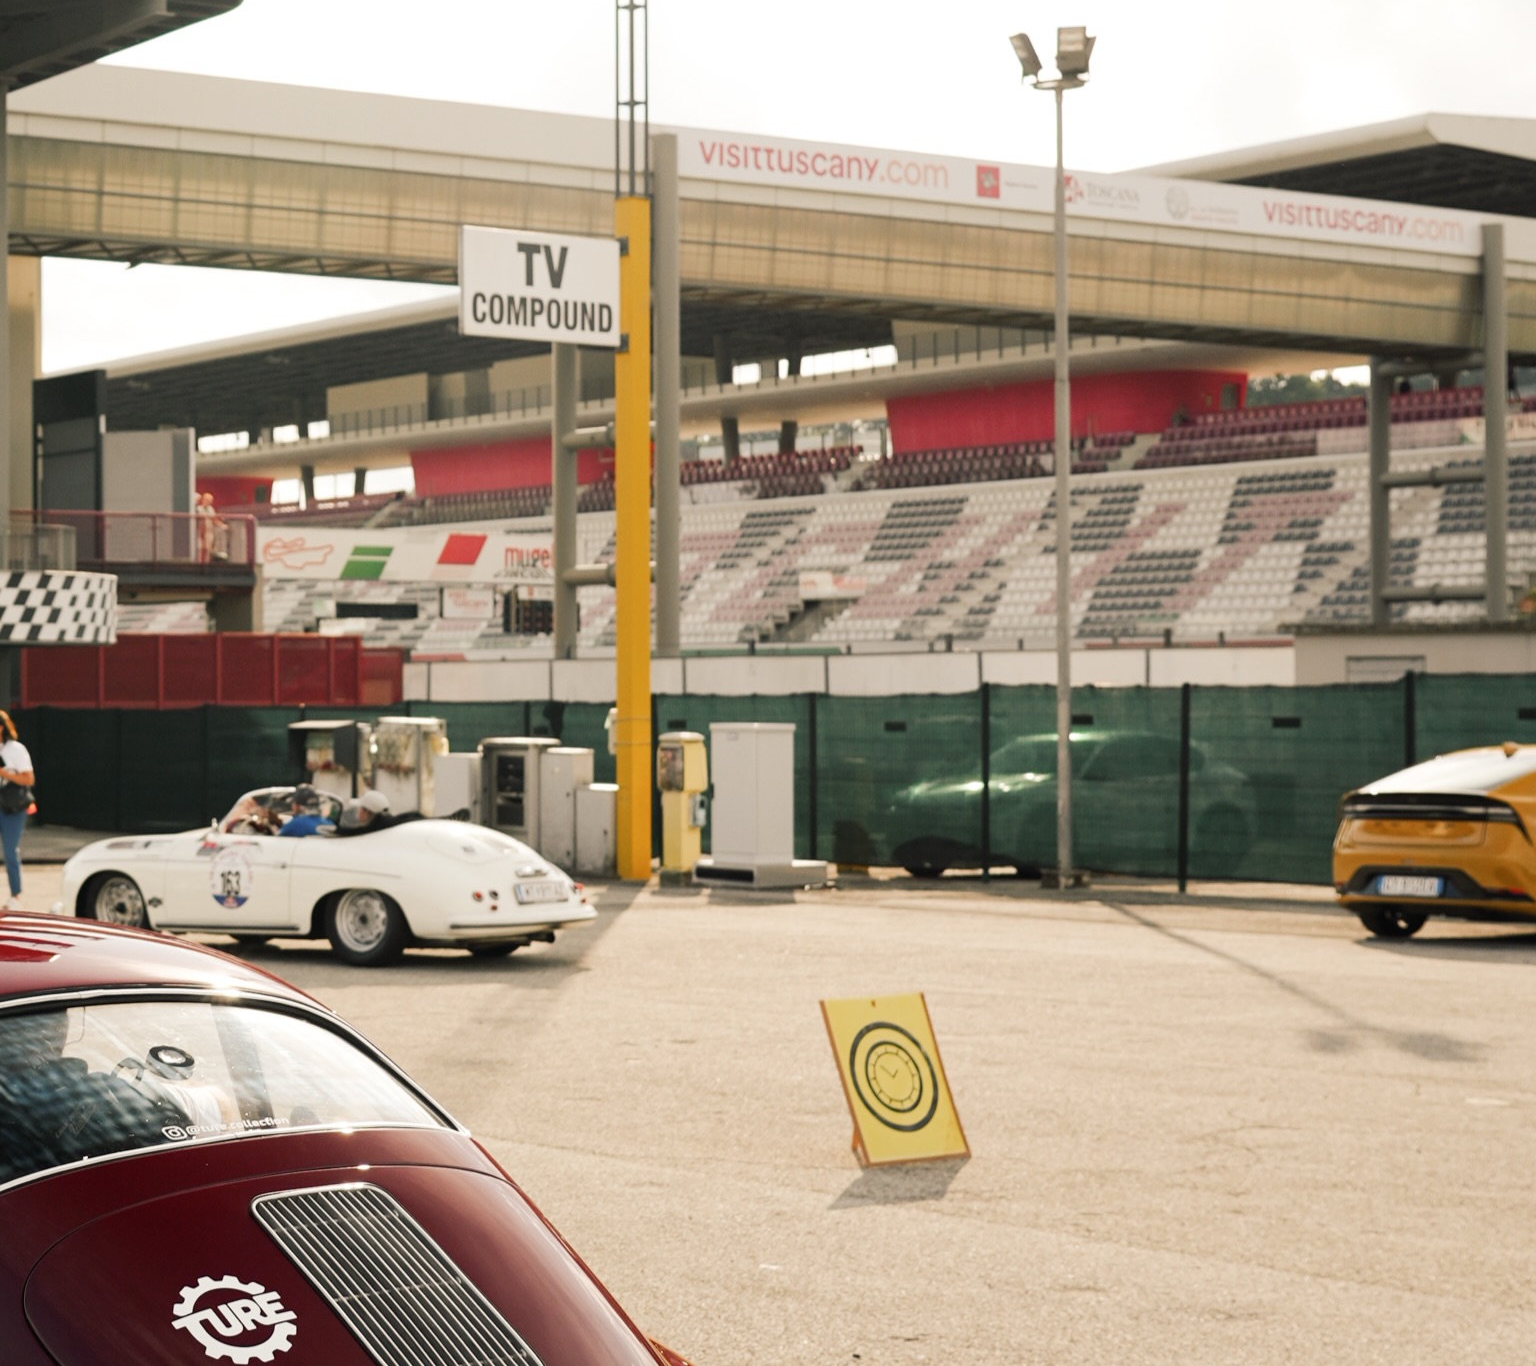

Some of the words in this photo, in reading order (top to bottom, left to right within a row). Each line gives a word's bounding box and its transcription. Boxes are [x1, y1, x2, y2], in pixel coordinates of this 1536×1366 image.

[516, 241, 569, 290] TV
[471, 291, 613, 333] COMPOUND
[220, 870, 241, 895] 163
[171, 1290, 298, 1338] TURE
